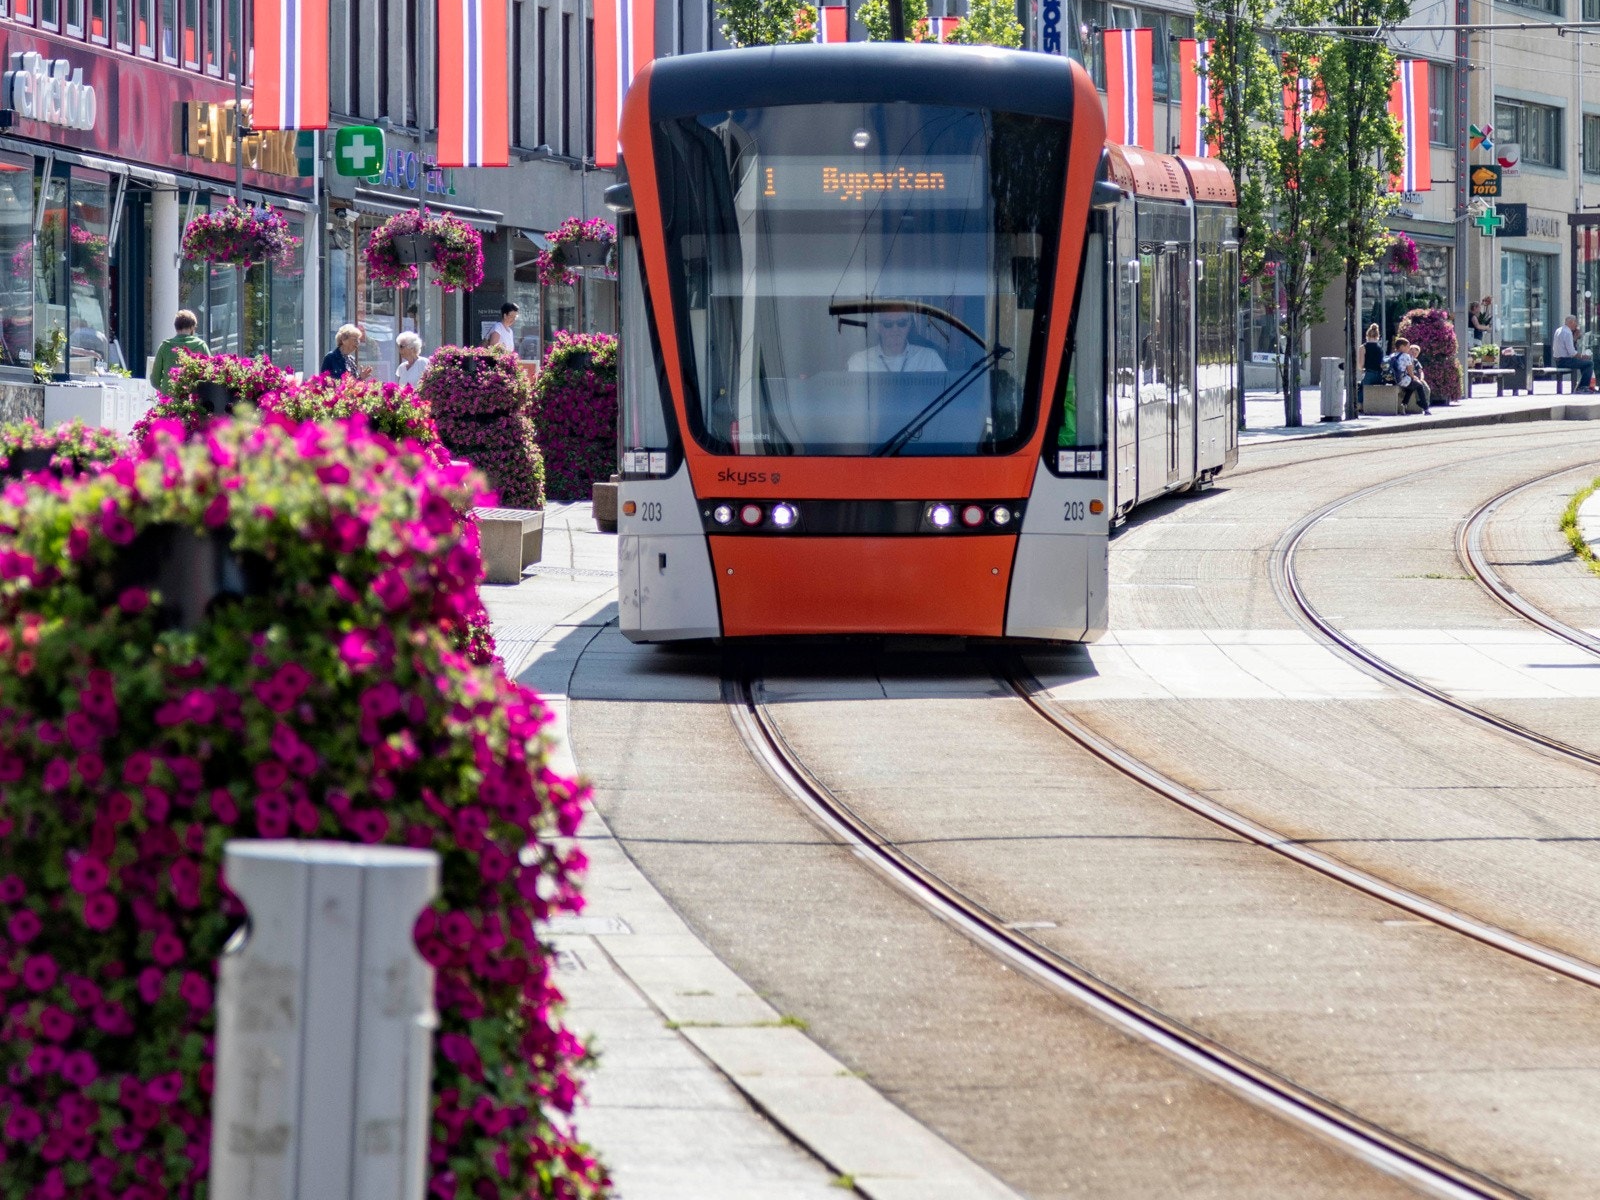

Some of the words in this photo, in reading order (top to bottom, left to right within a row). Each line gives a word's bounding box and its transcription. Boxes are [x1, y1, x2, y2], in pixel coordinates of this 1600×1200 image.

[383, 147, 446, 195] APOEK
[764, 166, 776, 197] 1
[822, 166, 945, 201] Byparken
[1472, 185, 1497, 195] TOTO
[717, 467, 767, 486] skyss
[641, 502, 663, 523] 203
[1063, 501, 1085, 522] 203
